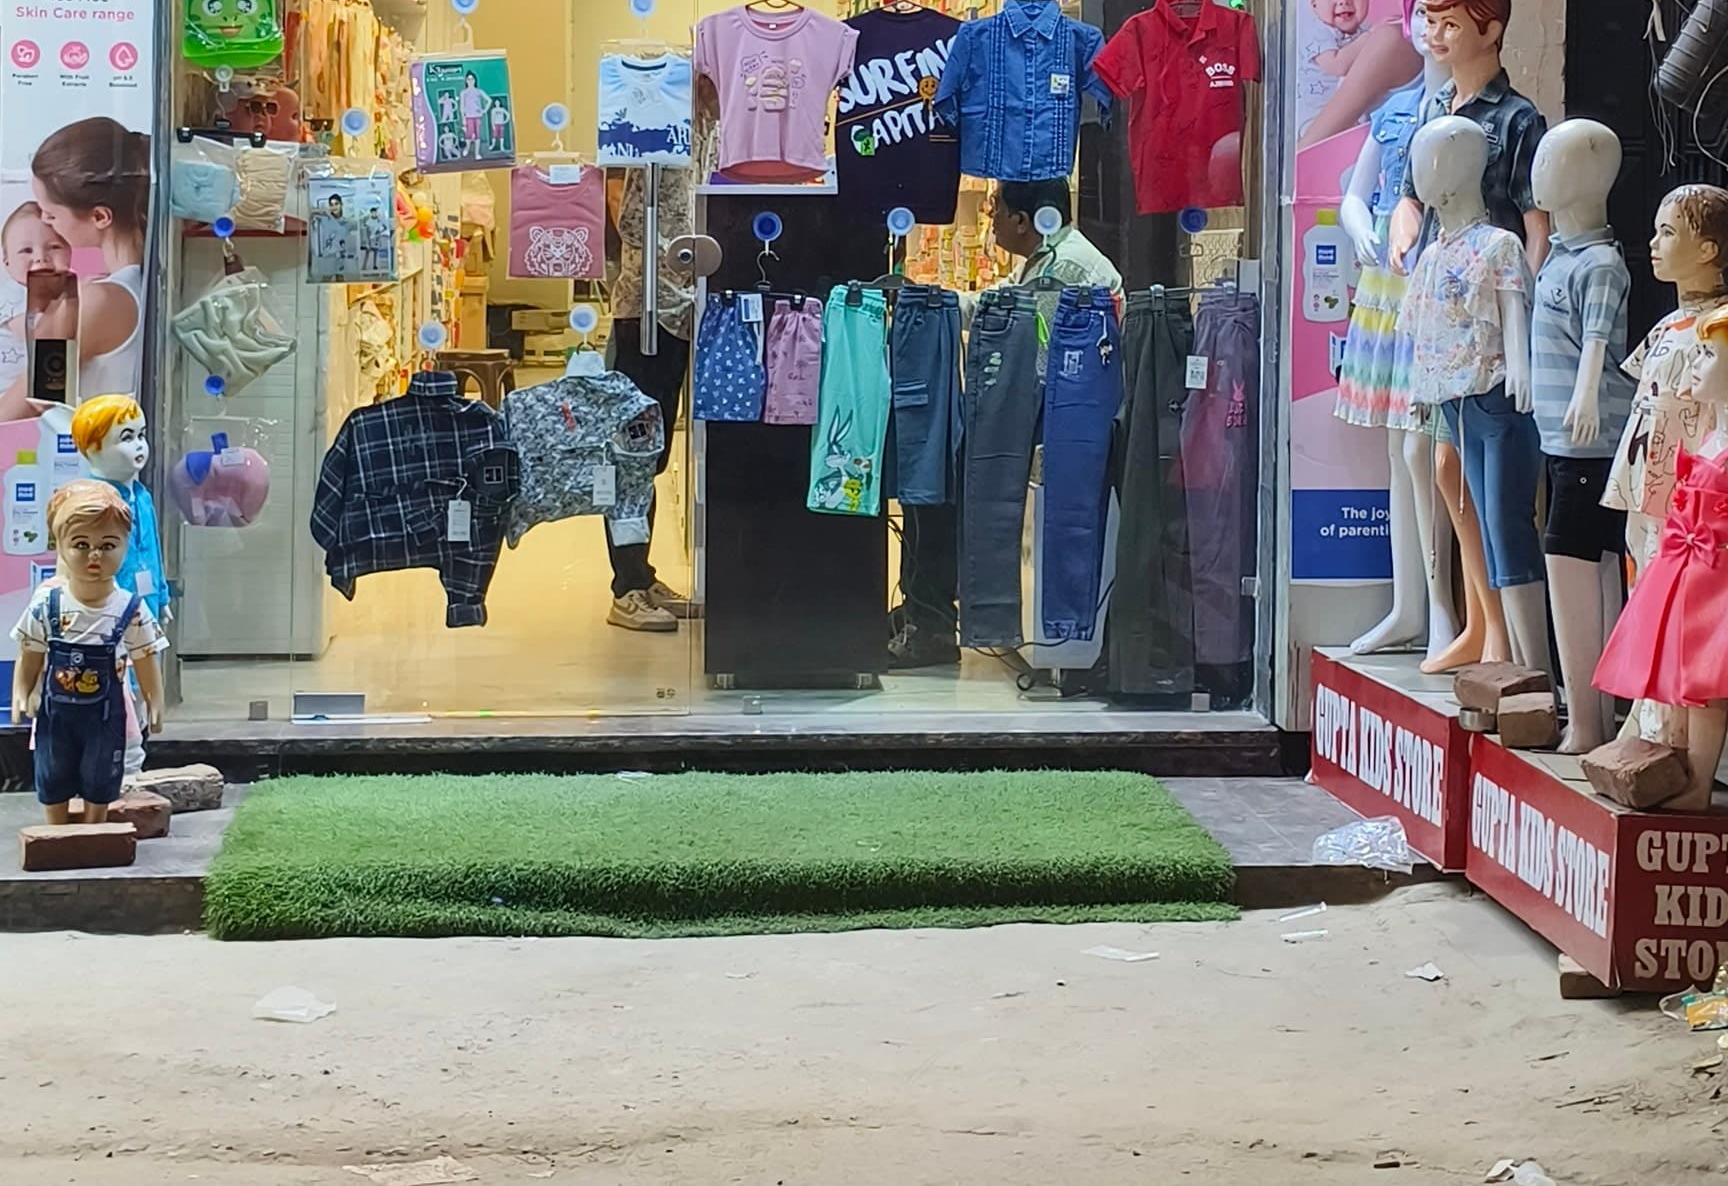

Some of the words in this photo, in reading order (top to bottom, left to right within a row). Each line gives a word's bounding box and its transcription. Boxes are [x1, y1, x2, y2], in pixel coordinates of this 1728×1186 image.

[15, 5, 48, 18] Skin
[52, 6, 88, 20] Care
[91, 9, 135, 21] range
[838, 35, 958, 114] SURFIN
[1320, 523, 1336, 537] of
[1341, 506, 1367, 519] The
[1315, 682, 1357, 777] GUPTA
[1358, 706, 1393, 797] KIDS
[1393, 725, 1444, 830] STORE
[1471, 771, 1516, 874] GUPTA
[1517, 800, 1555, 899] KIDS
[1555, 825, 1610, 940] STORE
